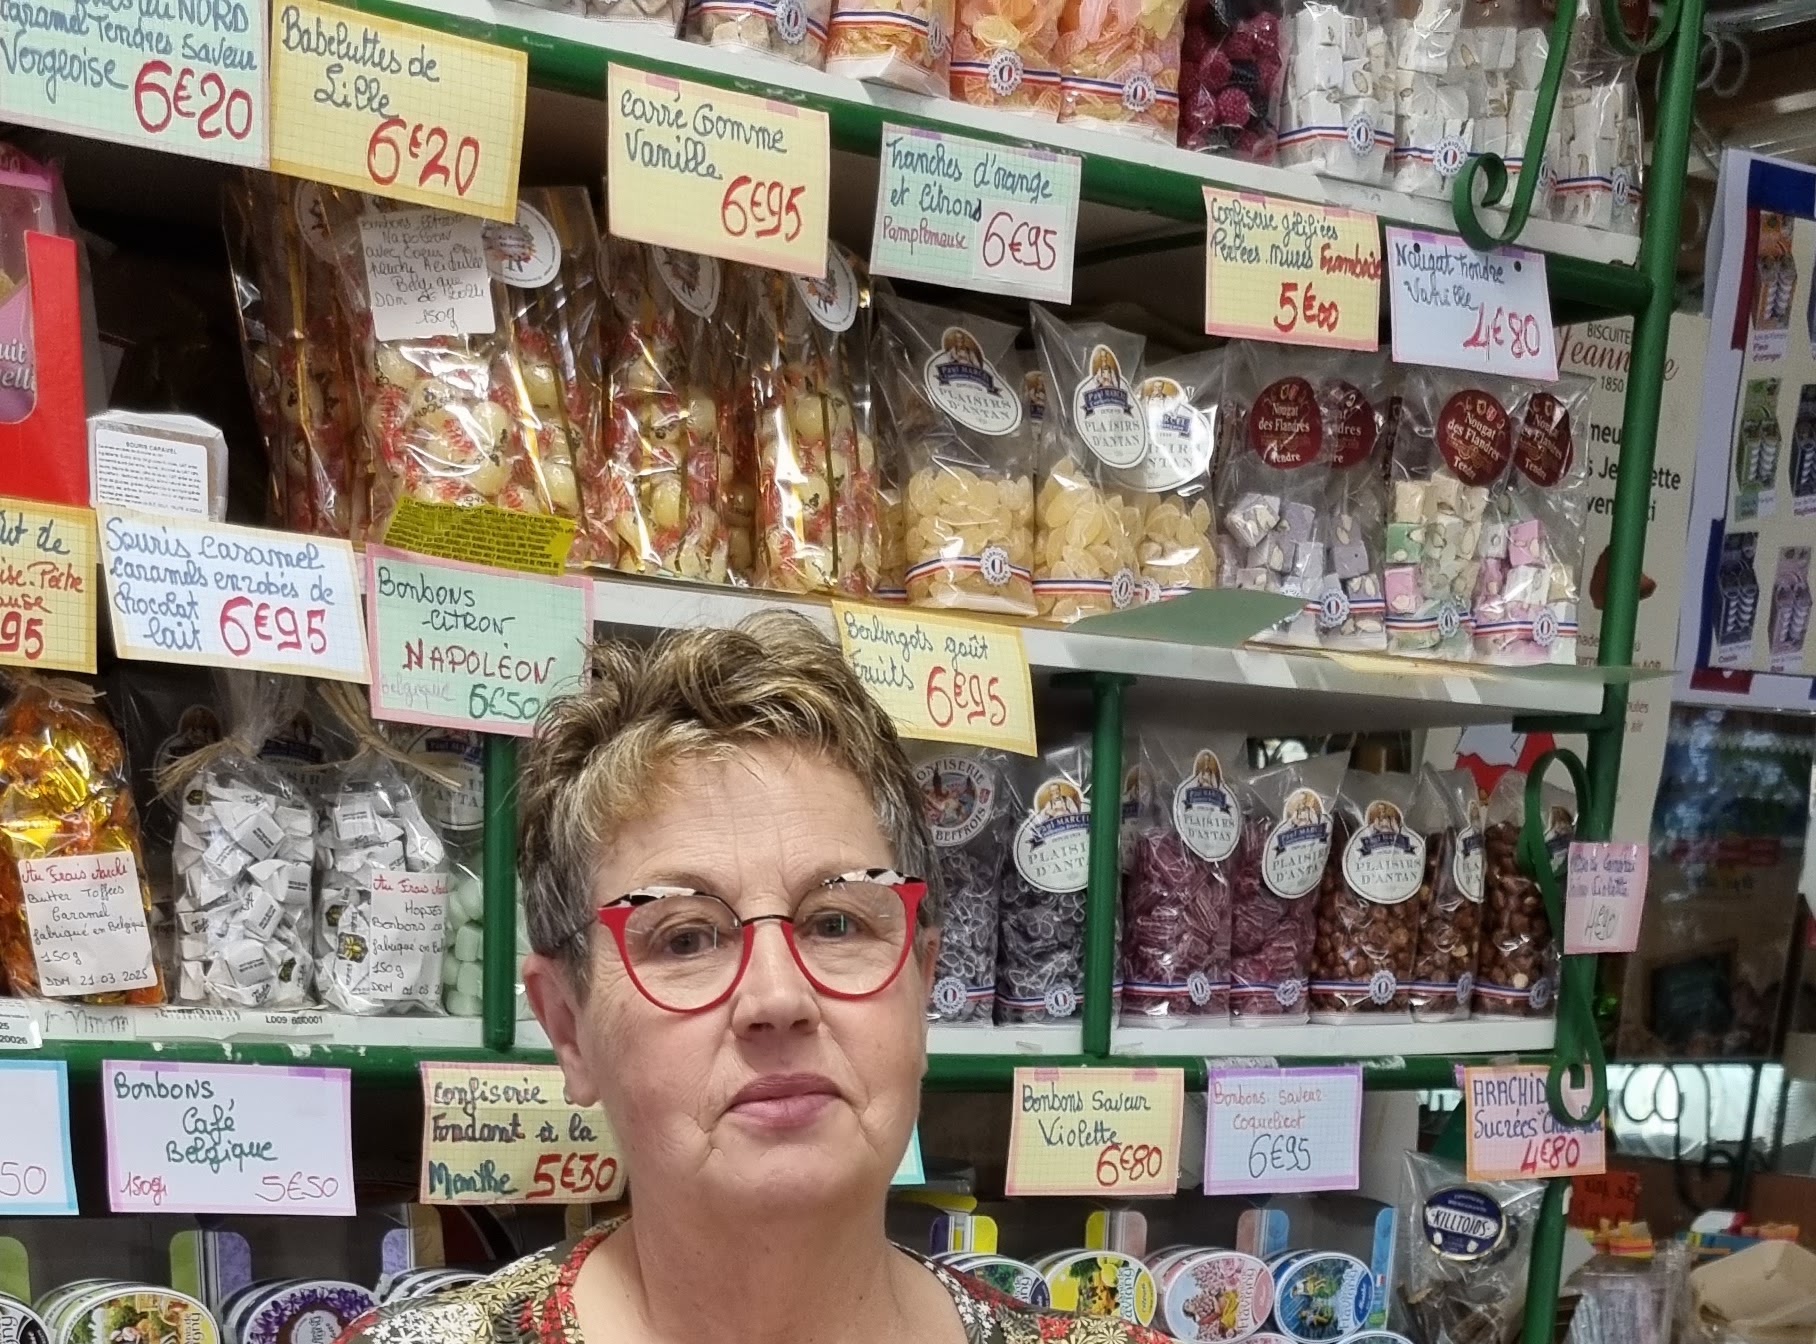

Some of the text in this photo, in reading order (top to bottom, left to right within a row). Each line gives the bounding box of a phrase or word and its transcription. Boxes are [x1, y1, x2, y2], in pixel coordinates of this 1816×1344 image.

[281, 5, 440, 82] Babeluttes de
[135, 60, 253, 140] 6€20
[314, 64, 399, 120] Lille
[367, 117, 480, 196] 6€20
[624, 128, 724, 181] Vanille
[890, 184, 915, 208] et
[973, 153, 1053, 204] d'orange
[721, 176, 806, 243] 6€95
[982, 211, 1057, 272] 6€95
[1273, 282, 1339, 334] 5€00
[1463, 302, 1540, 361] 4€80
[1600, 376, 1624, 393] 1850
[1271, 401, 1300, 418] Nougat
[1274, 419, 1311, 434] Flandres
[1464, 411, 1498, 441] Nougat
[1464, 428, 1501, 460] Flandres
[36, 519, 71, 556] de
[104, 516, 193, 560] Souris
[213, 570, 336, 608] enrobés de
[143, 615, 201, 652] lait
[219, 597, 330, 658] 6€95
[944, 635, 990, 671] goût
[468, 683, 541, 721] 6€50
[926, 664, 1007, 730] 6€95
[21, 860, 45, 884] Au
[45, 863, 87, 884] Frais
[27, 890, 72, 904] Butter
[51, 906, 111, 922] Caramel
[33, 916, 147, 946] fabriqué Belgique
[40, 950, 83, 966] 150g
[371, 960, 404, 979] 150g
[1022, 1082, 1153, 1113] Bonbons Saveur
[1213, 1081, 1266, 1105] Bonbons
[182, 1098, 236, 1137] Café
[431, 1112, 598, 1144] Fondant à la
[1038, 1117, 1123, 1149] Violette
[1473, 1110, 1538, 1140] Sucrées
[165, 1138, 278, 1175] Belgique
[1096, 1142, 1163, 1188] 6€80
[1247, 1134, 1313, 1180] 6€95
[1519, 1134, 1581, 1174] 4€80
[255, 1172, 341, 1202] 5€50
[429, 1152, 619, 1200] Menthe 5€30
